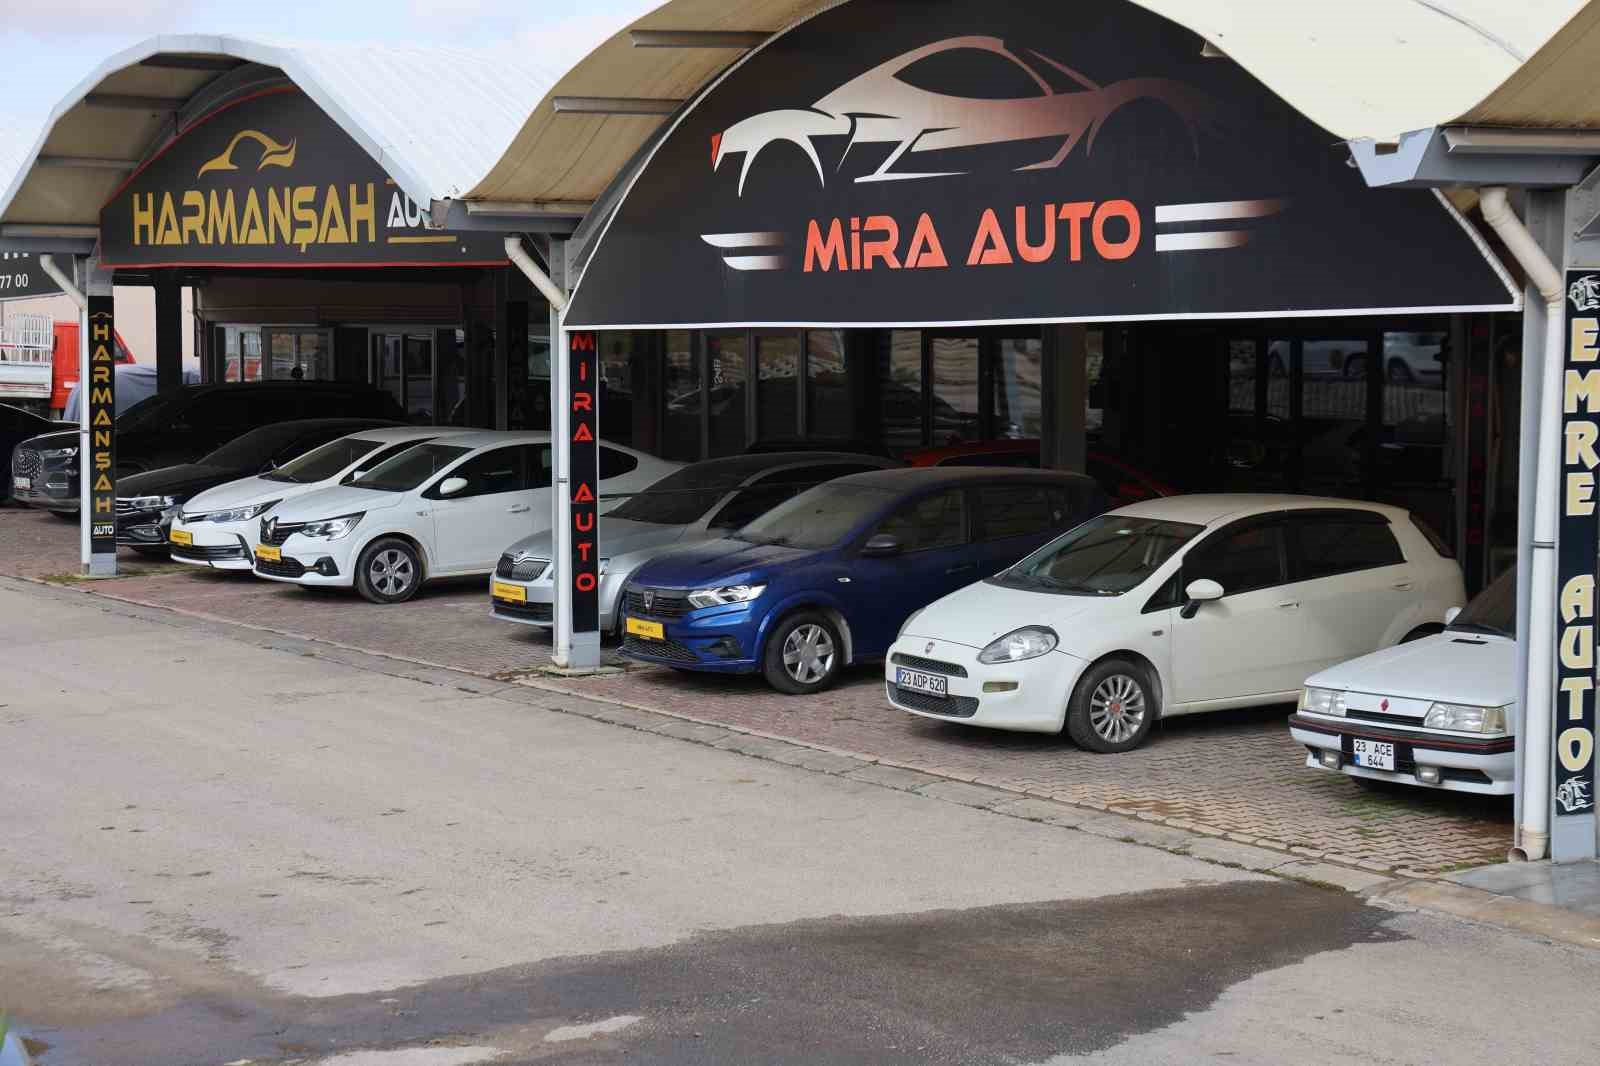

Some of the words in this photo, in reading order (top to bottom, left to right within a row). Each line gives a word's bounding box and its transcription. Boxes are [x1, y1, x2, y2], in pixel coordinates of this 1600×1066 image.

[132, 183, 376, 253] HARMANŞAH
[967, 199, 1141, 265] AUTO
[15, 273, 29, 288] 00
[1563, 317, 1600, 517] EMRE
[93, 525, 114, 535] AUTO
[574, 482, 596, 592] AUTO
[901, 670, 912, 685] 23
[912, 673, 928, 689] ADP
[929, 676, 946, 693] 620
[1557, 574, 1596, 772] AUTO
[1355, 740, 1367, 752] 23
[1374, 743, 1393, 757] ACE
[1367, 755, 1384, 768] 644
